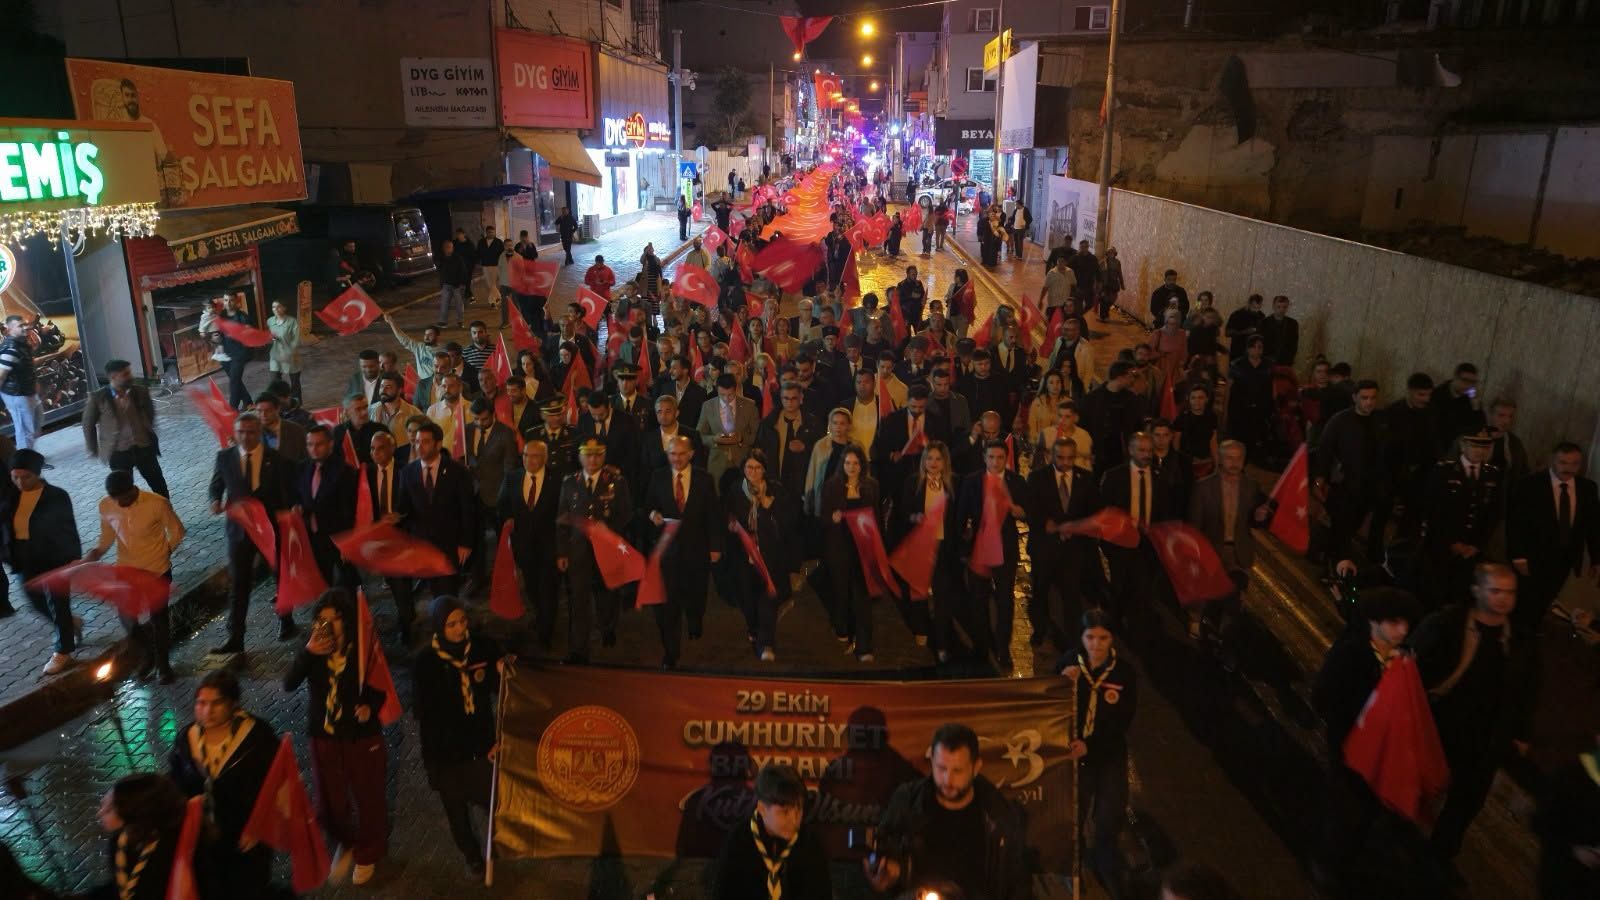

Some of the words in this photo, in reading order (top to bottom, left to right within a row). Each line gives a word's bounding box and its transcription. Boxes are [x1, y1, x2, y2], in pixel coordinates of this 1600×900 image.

[411, 68, 439, 80] DYG
[444, 65, 484, 80] GİYİM
[513, 63, 548, 89] DYG
[552, 65, 579, 89] GİYİM
[189, 94, 280, 146] SEFA
[604, 118, 627, 145] DYG
[0, 131, 104, 204] EMİŞ
[181, 154, 298, 196] ŞALGAM
[214, 231, 240, 250] SEFA
[736, 690, 766, 712] 29
[772, 689, 829, 713] EKİM
[683, 716, 886, 748] CUMHURİYET
